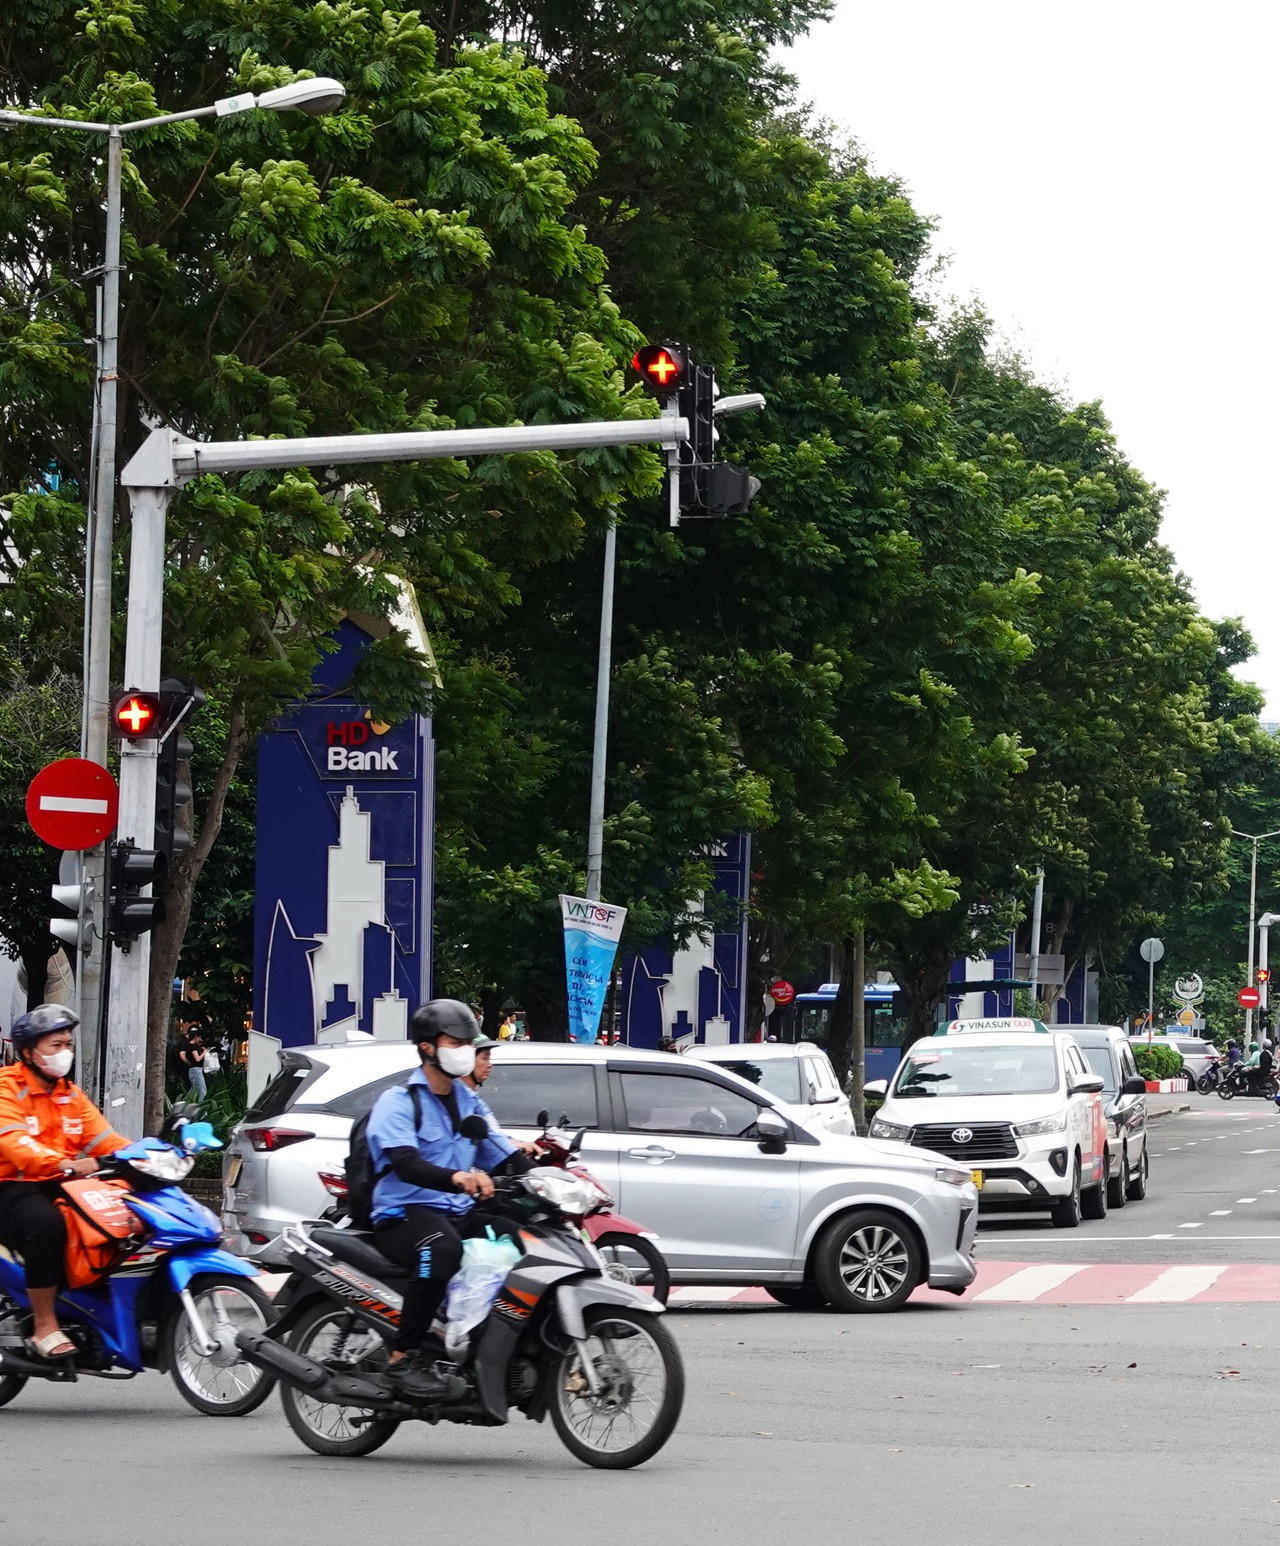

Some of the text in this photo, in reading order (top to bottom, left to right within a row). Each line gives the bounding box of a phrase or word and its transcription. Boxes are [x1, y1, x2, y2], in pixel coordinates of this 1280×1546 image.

[327, 721, 368, 746] HD
[328, 746, 399, 770] Bank
[968, 1020, 1031, 1030] VINASUN TAXI
